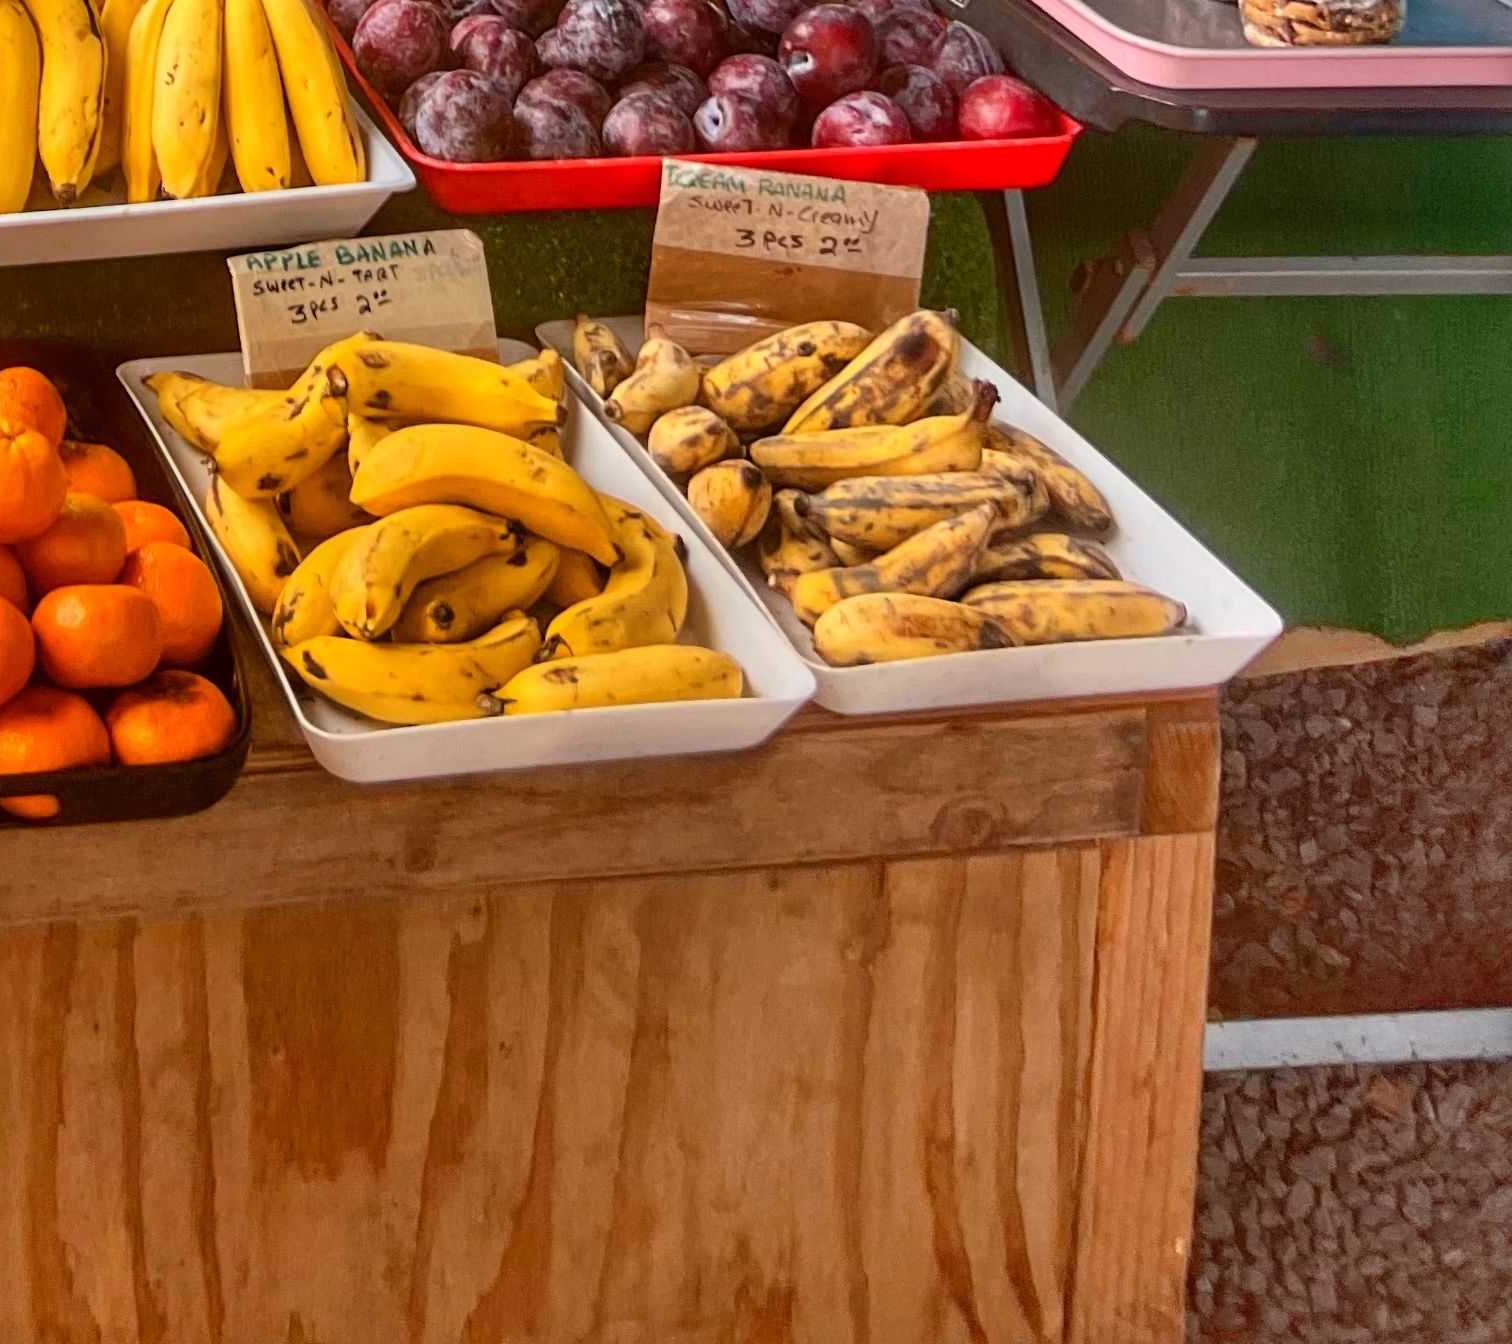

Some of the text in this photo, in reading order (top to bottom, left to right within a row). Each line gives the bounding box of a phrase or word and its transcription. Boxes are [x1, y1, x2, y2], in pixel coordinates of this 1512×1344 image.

[734, 228, 756, 249] 3
[245, 237, 437, 272] APPLE BANANA
